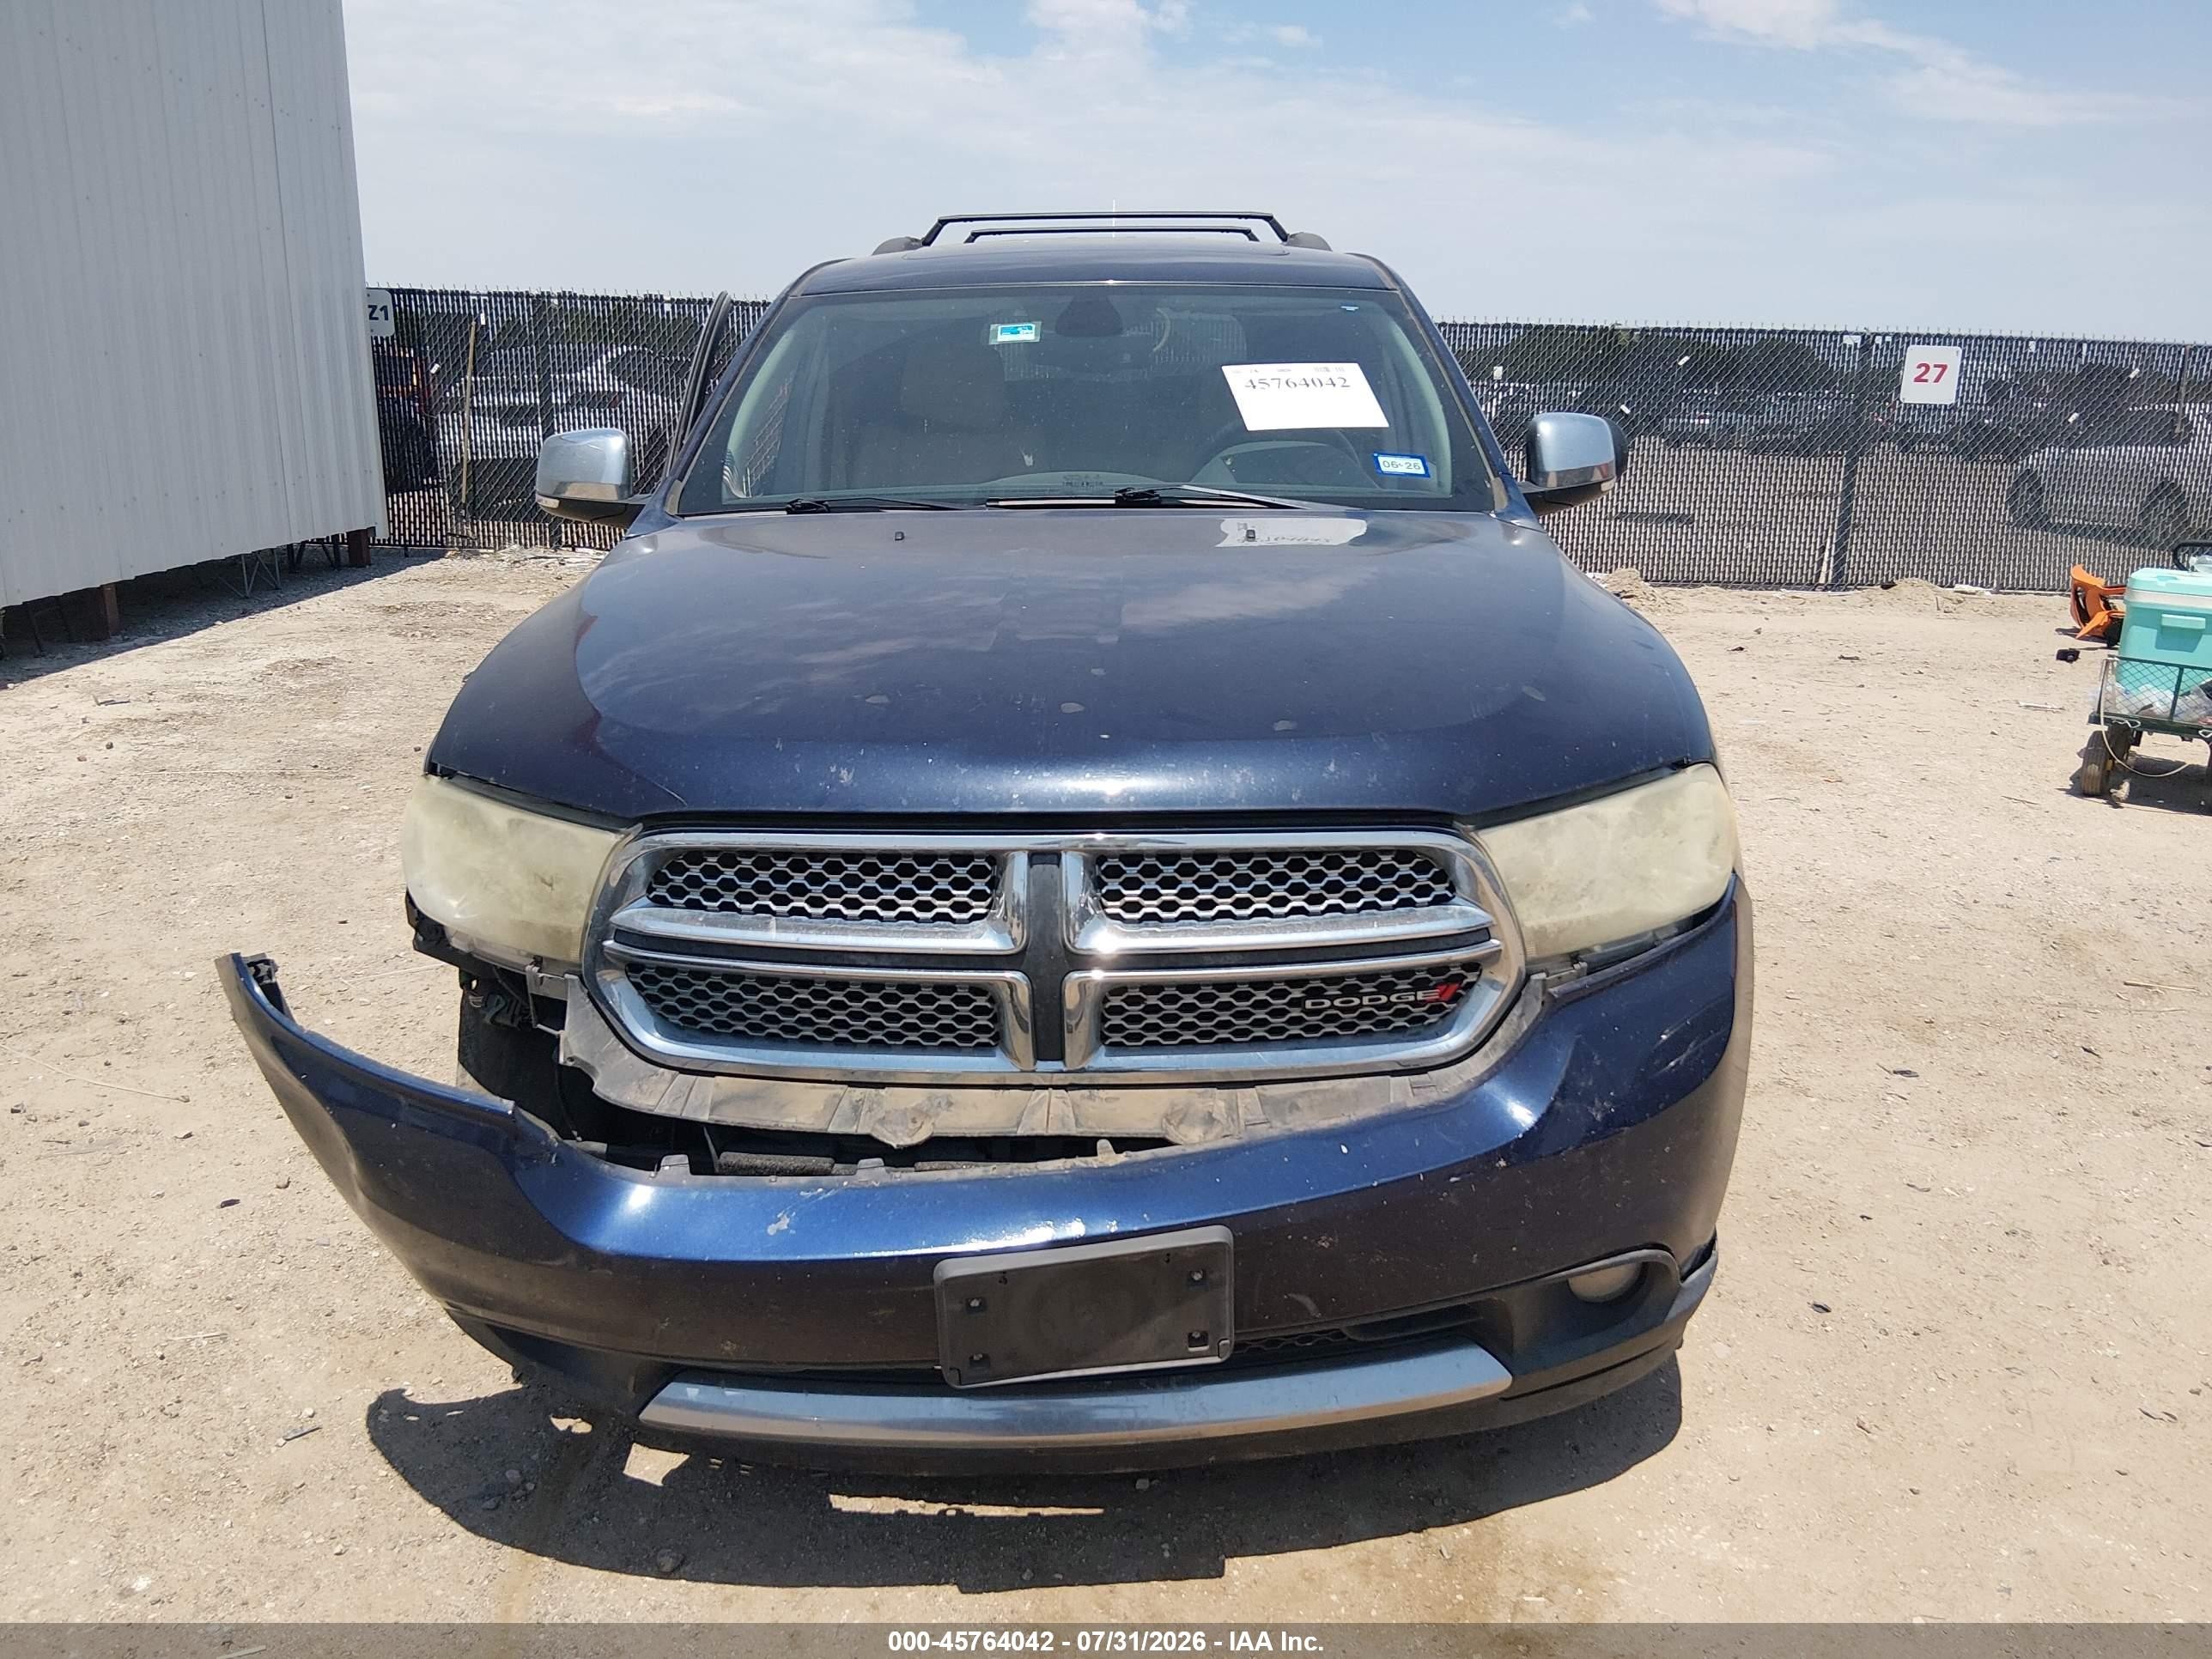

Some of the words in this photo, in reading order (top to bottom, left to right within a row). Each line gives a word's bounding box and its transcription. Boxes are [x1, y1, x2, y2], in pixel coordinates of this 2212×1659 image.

[1244, 376, 1351, 390] 45764042
[1913, 362, 1948, 383] 27
[1304, 988, 1441, 1010] DODGE
